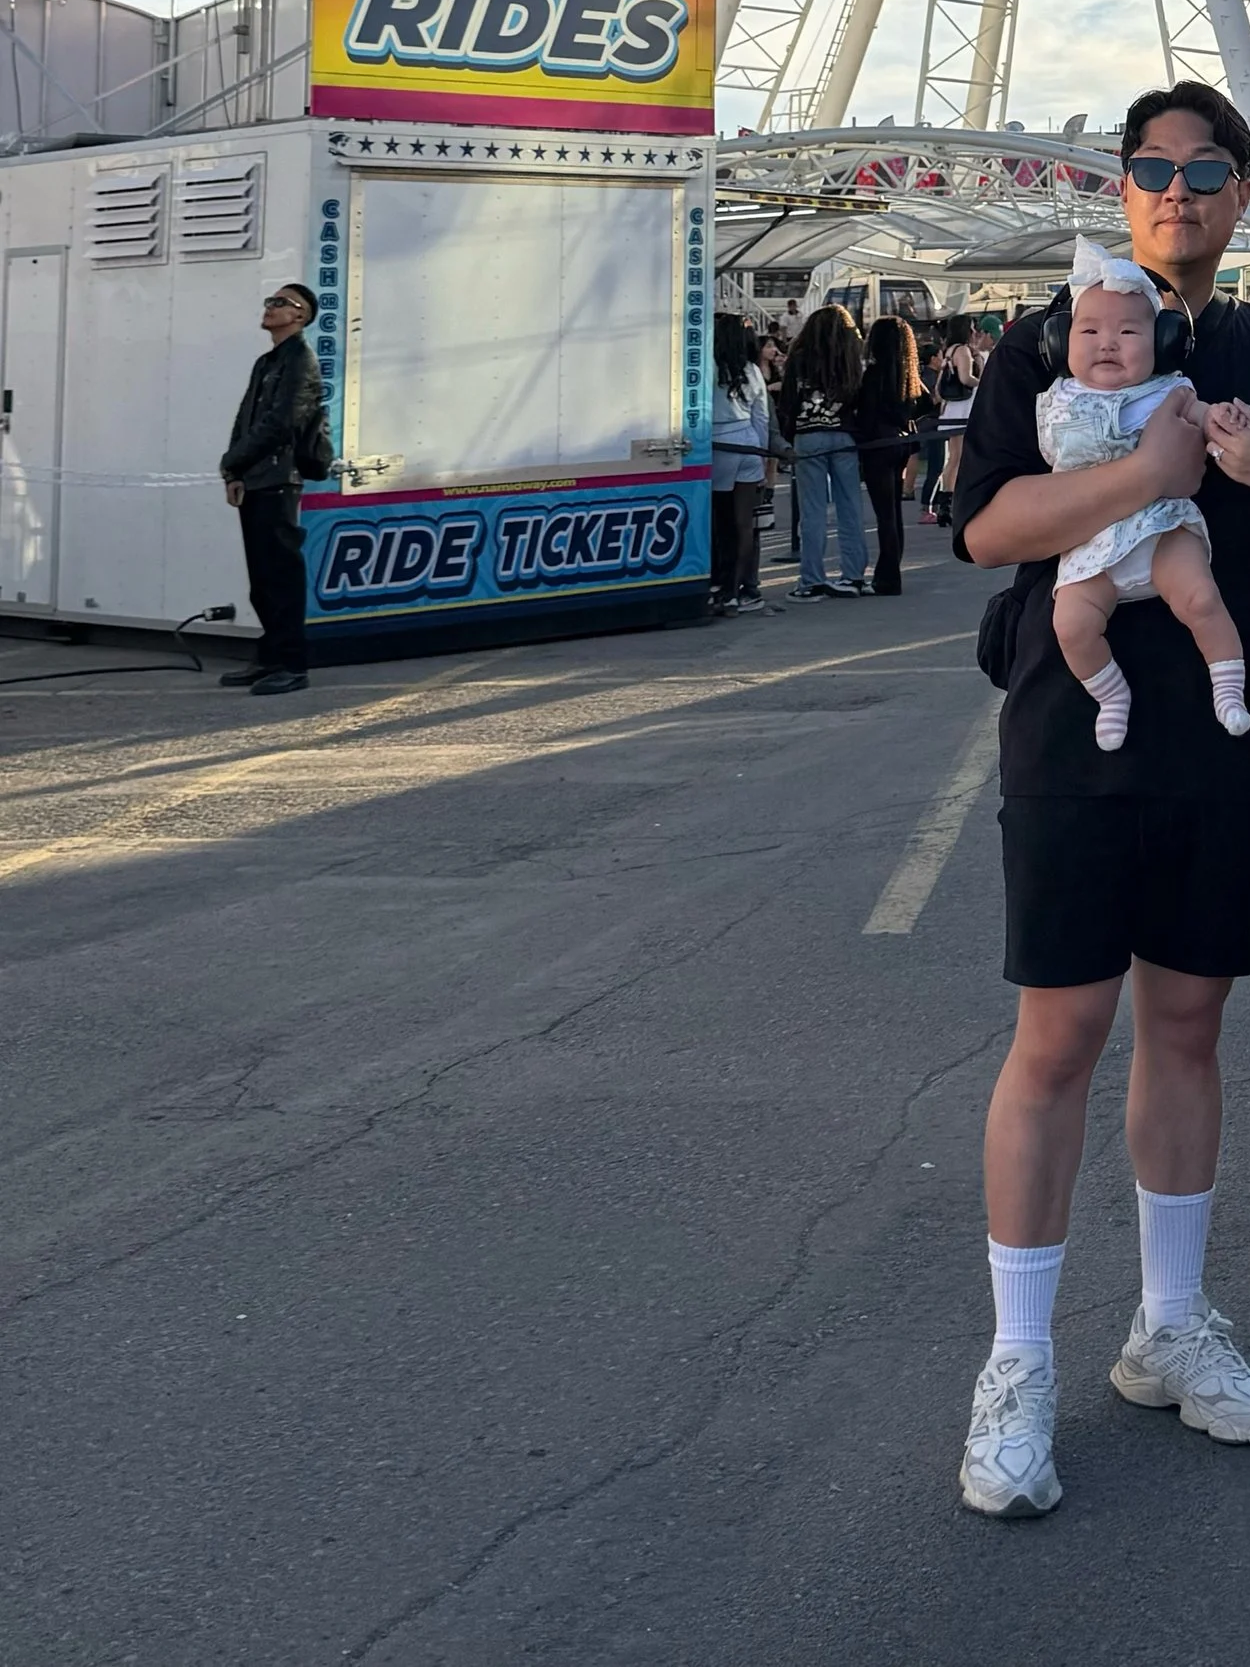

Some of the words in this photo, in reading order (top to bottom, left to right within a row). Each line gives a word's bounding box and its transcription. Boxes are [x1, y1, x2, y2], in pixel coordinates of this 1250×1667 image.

[319, 199, 340, 287] CASH
[688, 207, 704, 286] CASH
[319, 293, 338, 310] OR
[686, 307, 703, 429] CREDIT
[443, 479, 577, 496] www.namidway.com
[320, 519, 482, 597] RIDE
[498, 502, 684, 579] TICKETS
